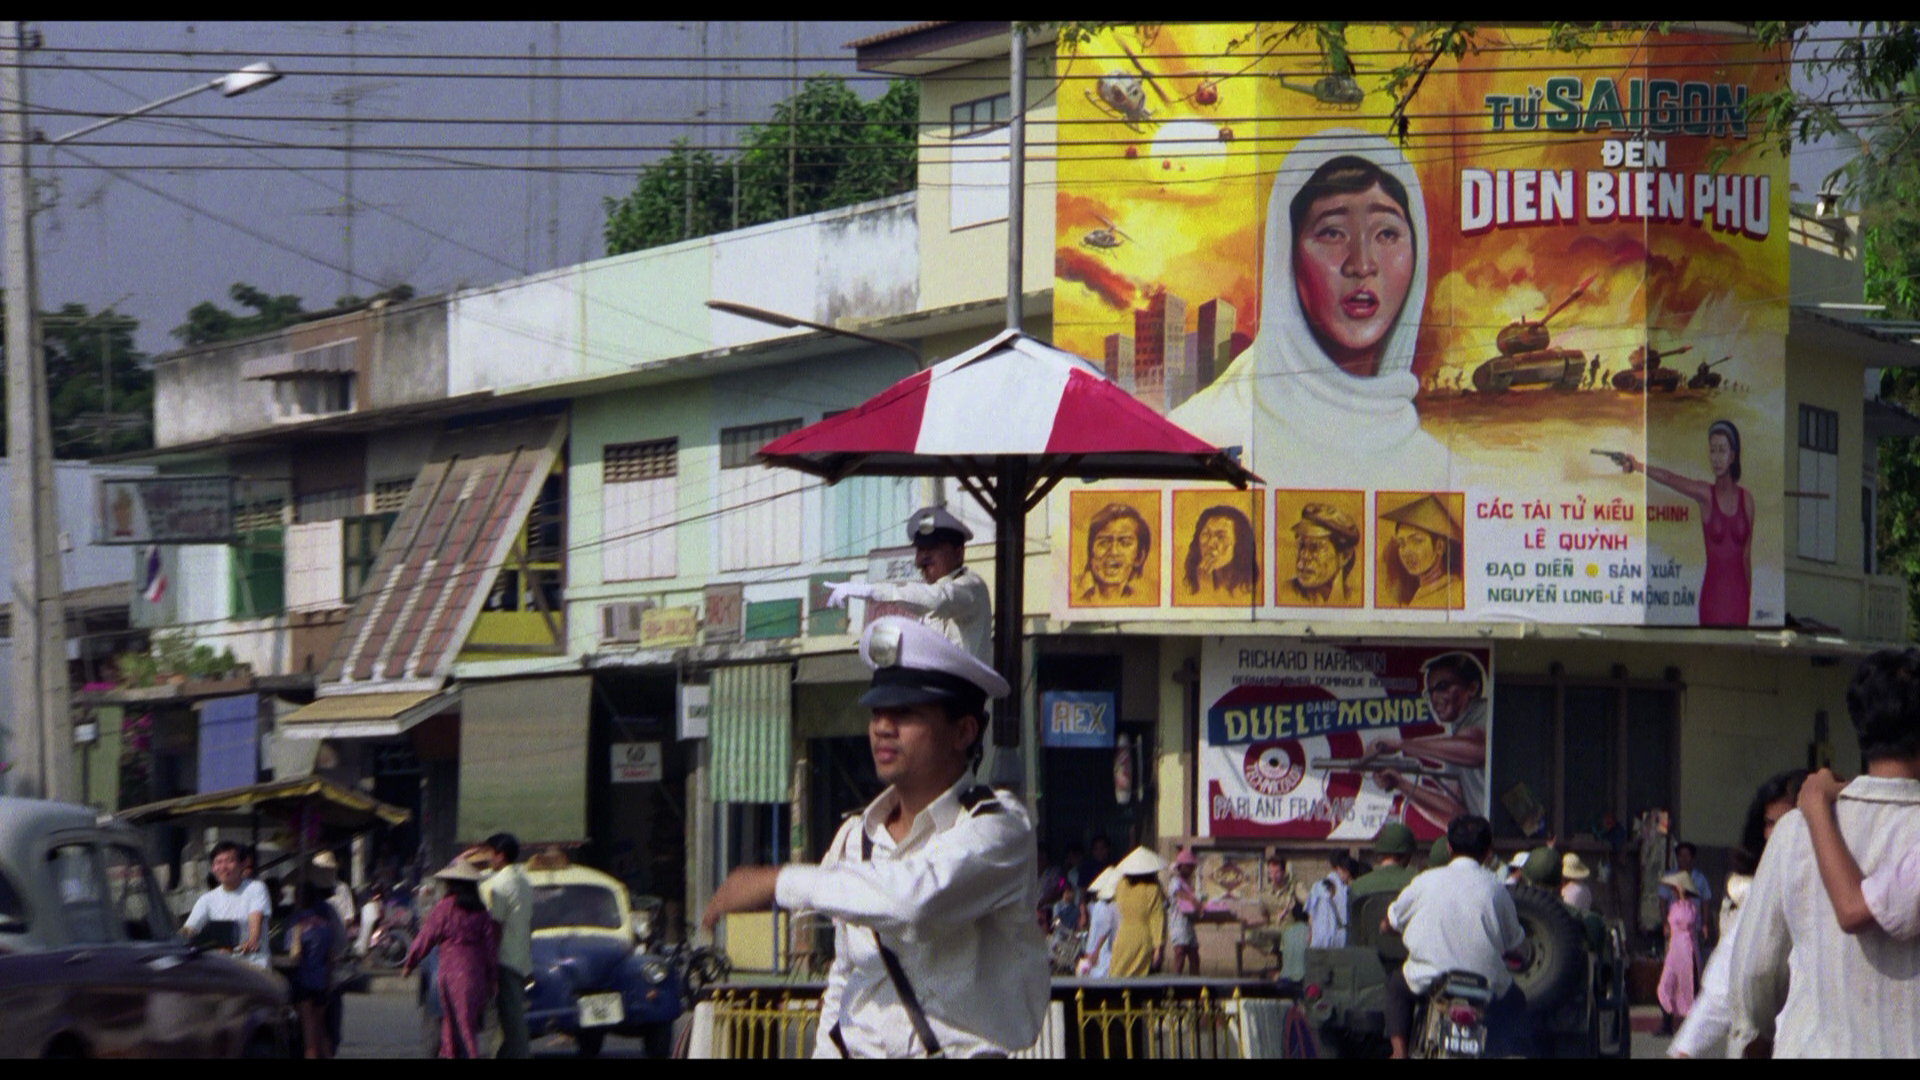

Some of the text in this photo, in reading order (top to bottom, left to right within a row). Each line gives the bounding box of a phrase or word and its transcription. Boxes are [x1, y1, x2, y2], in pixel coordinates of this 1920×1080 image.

[1546, 77, 1747, 138] SAIGON
[1601, 132, 1666, 168] ĐẾN
[1461, 168, 1771, 237] DIEN BIEN PHU
[1477, 496, 1513, 519] CÁC
[1646, 504, 1689, 521] CHINH
[1524, 526, 1546, 549] LÊ
[1486, 562, 1525, 580] ĐẠO
[1563, 589, 1603, 604] LONG
[1610, 585, 1624, 605] LÊ
[1238, 649, 1387, 674] RICHARD HARRISON
[1051, 701, 1107, 735] REX
[1225, 699, 1428, 741] DUEL DANS MONDE
[1314, 714, 1331, 730] LE
[1214, 795, 1282, 820] PARLANT
